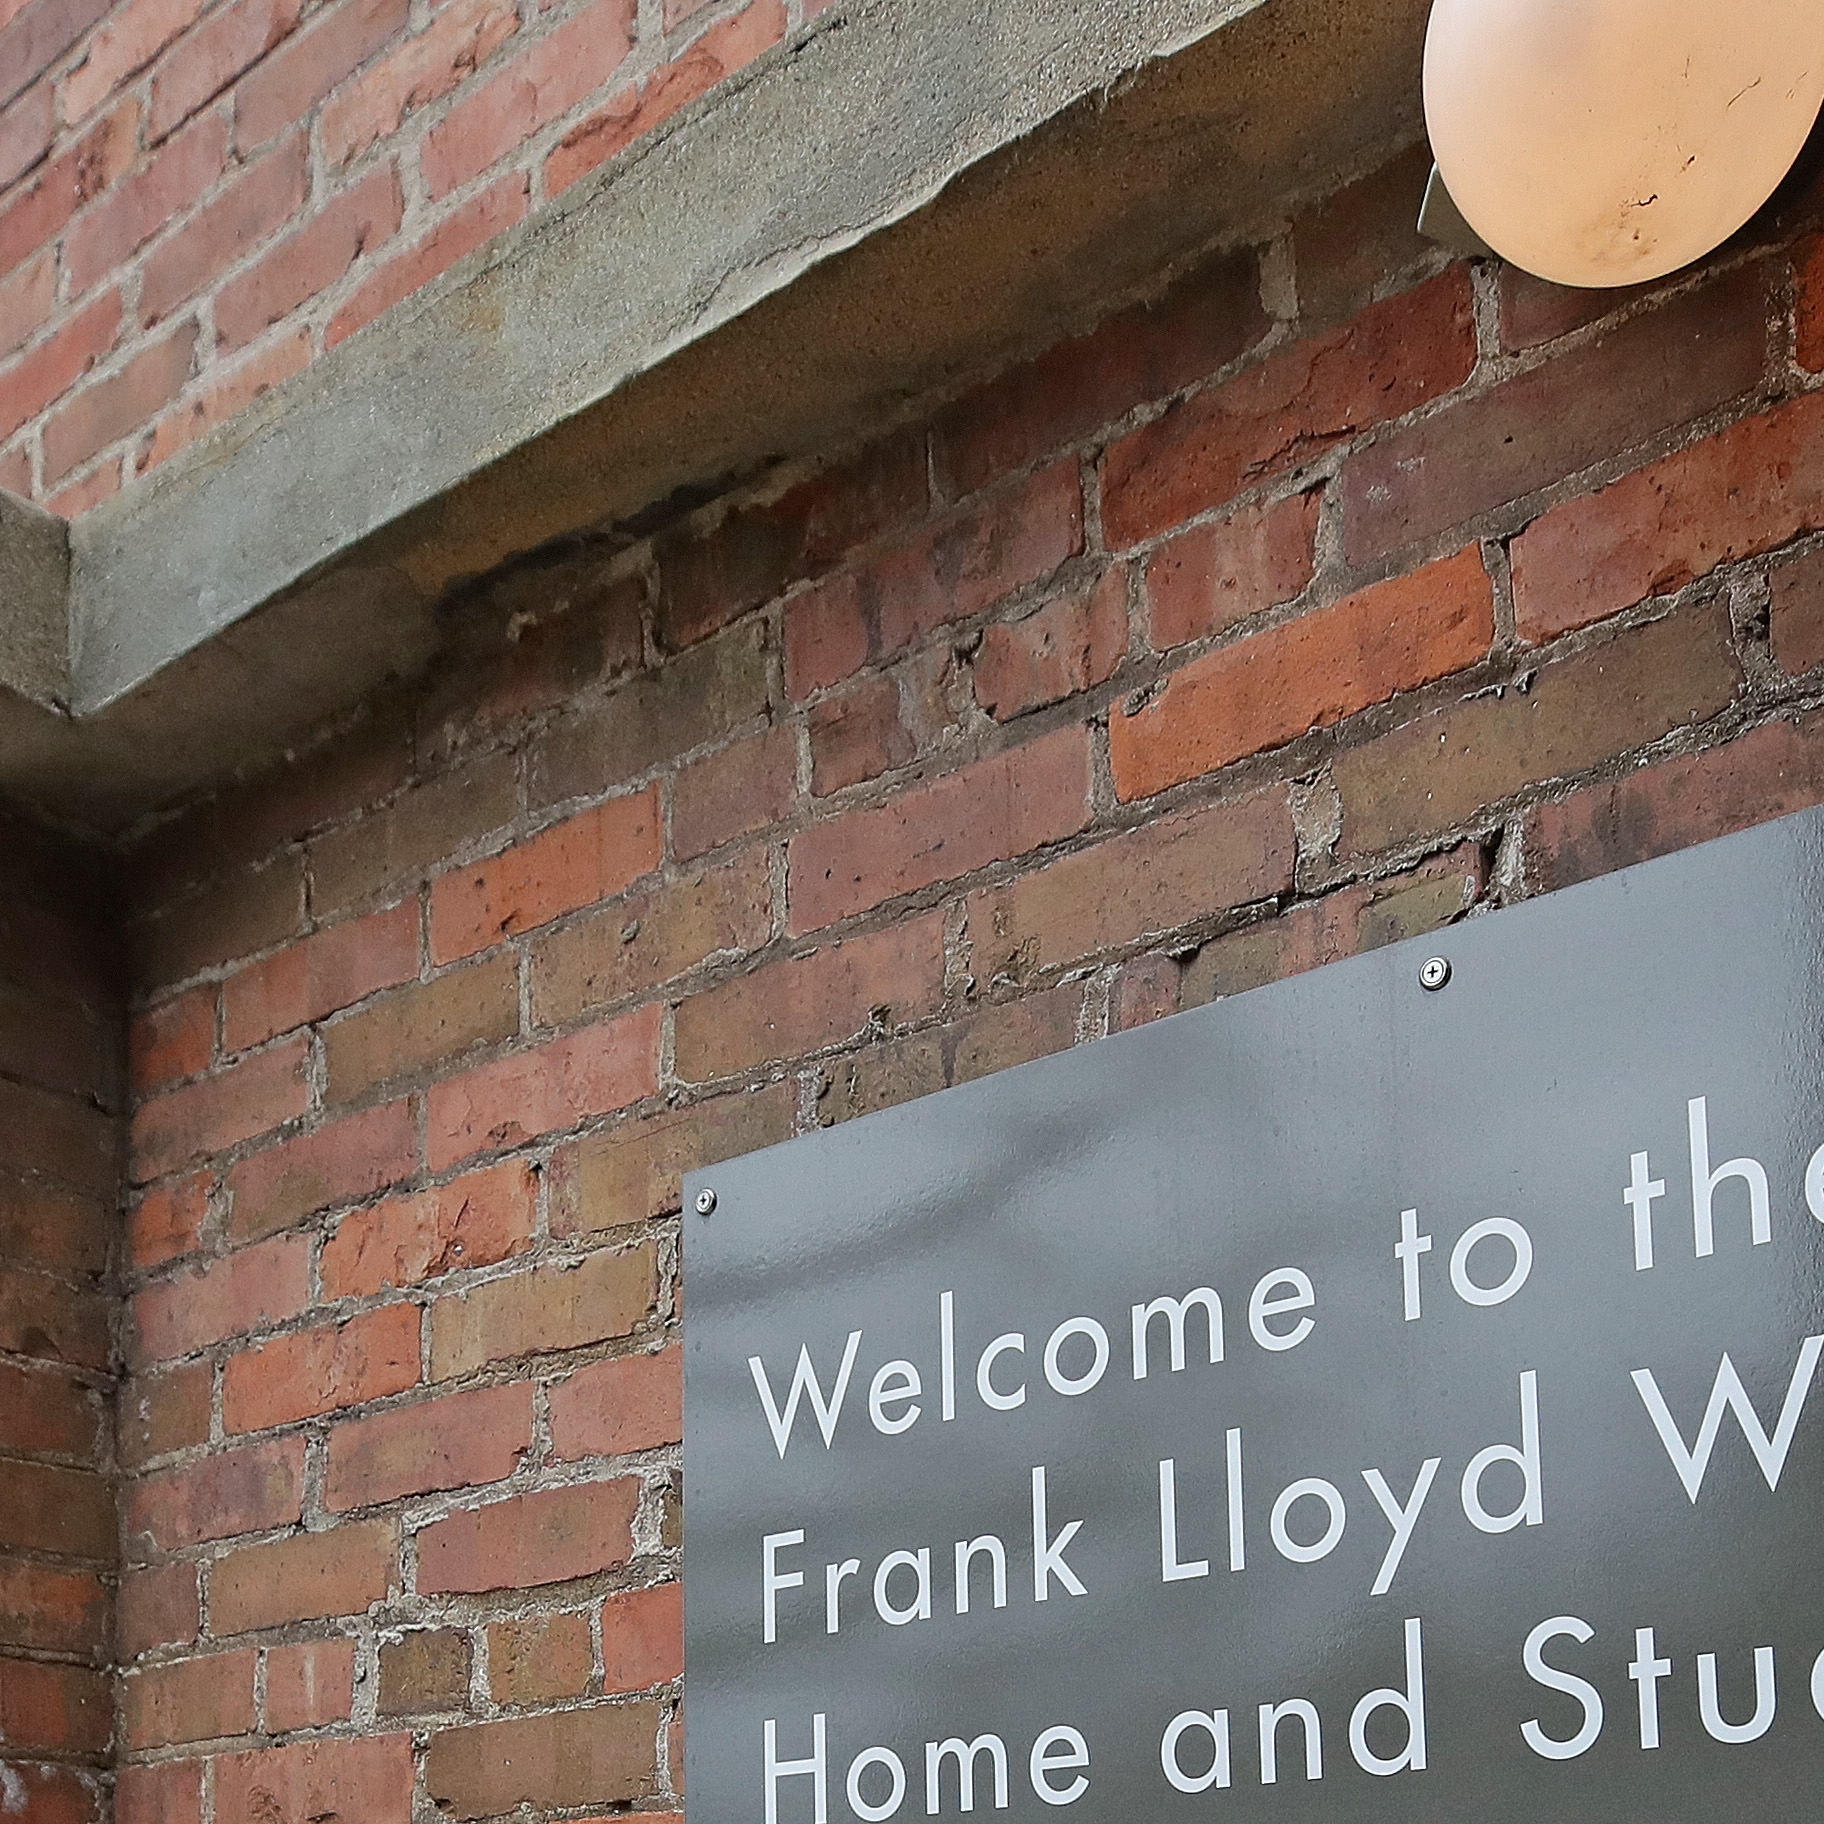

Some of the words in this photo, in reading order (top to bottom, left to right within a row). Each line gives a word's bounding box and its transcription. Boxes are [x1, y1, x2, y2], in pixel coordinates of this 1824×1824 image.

[746, 1266, 1316, 1460] Welcome
[1393, 1207, 1533, 1322] to
[762, 1464, 1089, 1644] Frank
[1158, 1368, 1544, 1596] Lloyd
[1159, 1616, 1427, 1794] and
